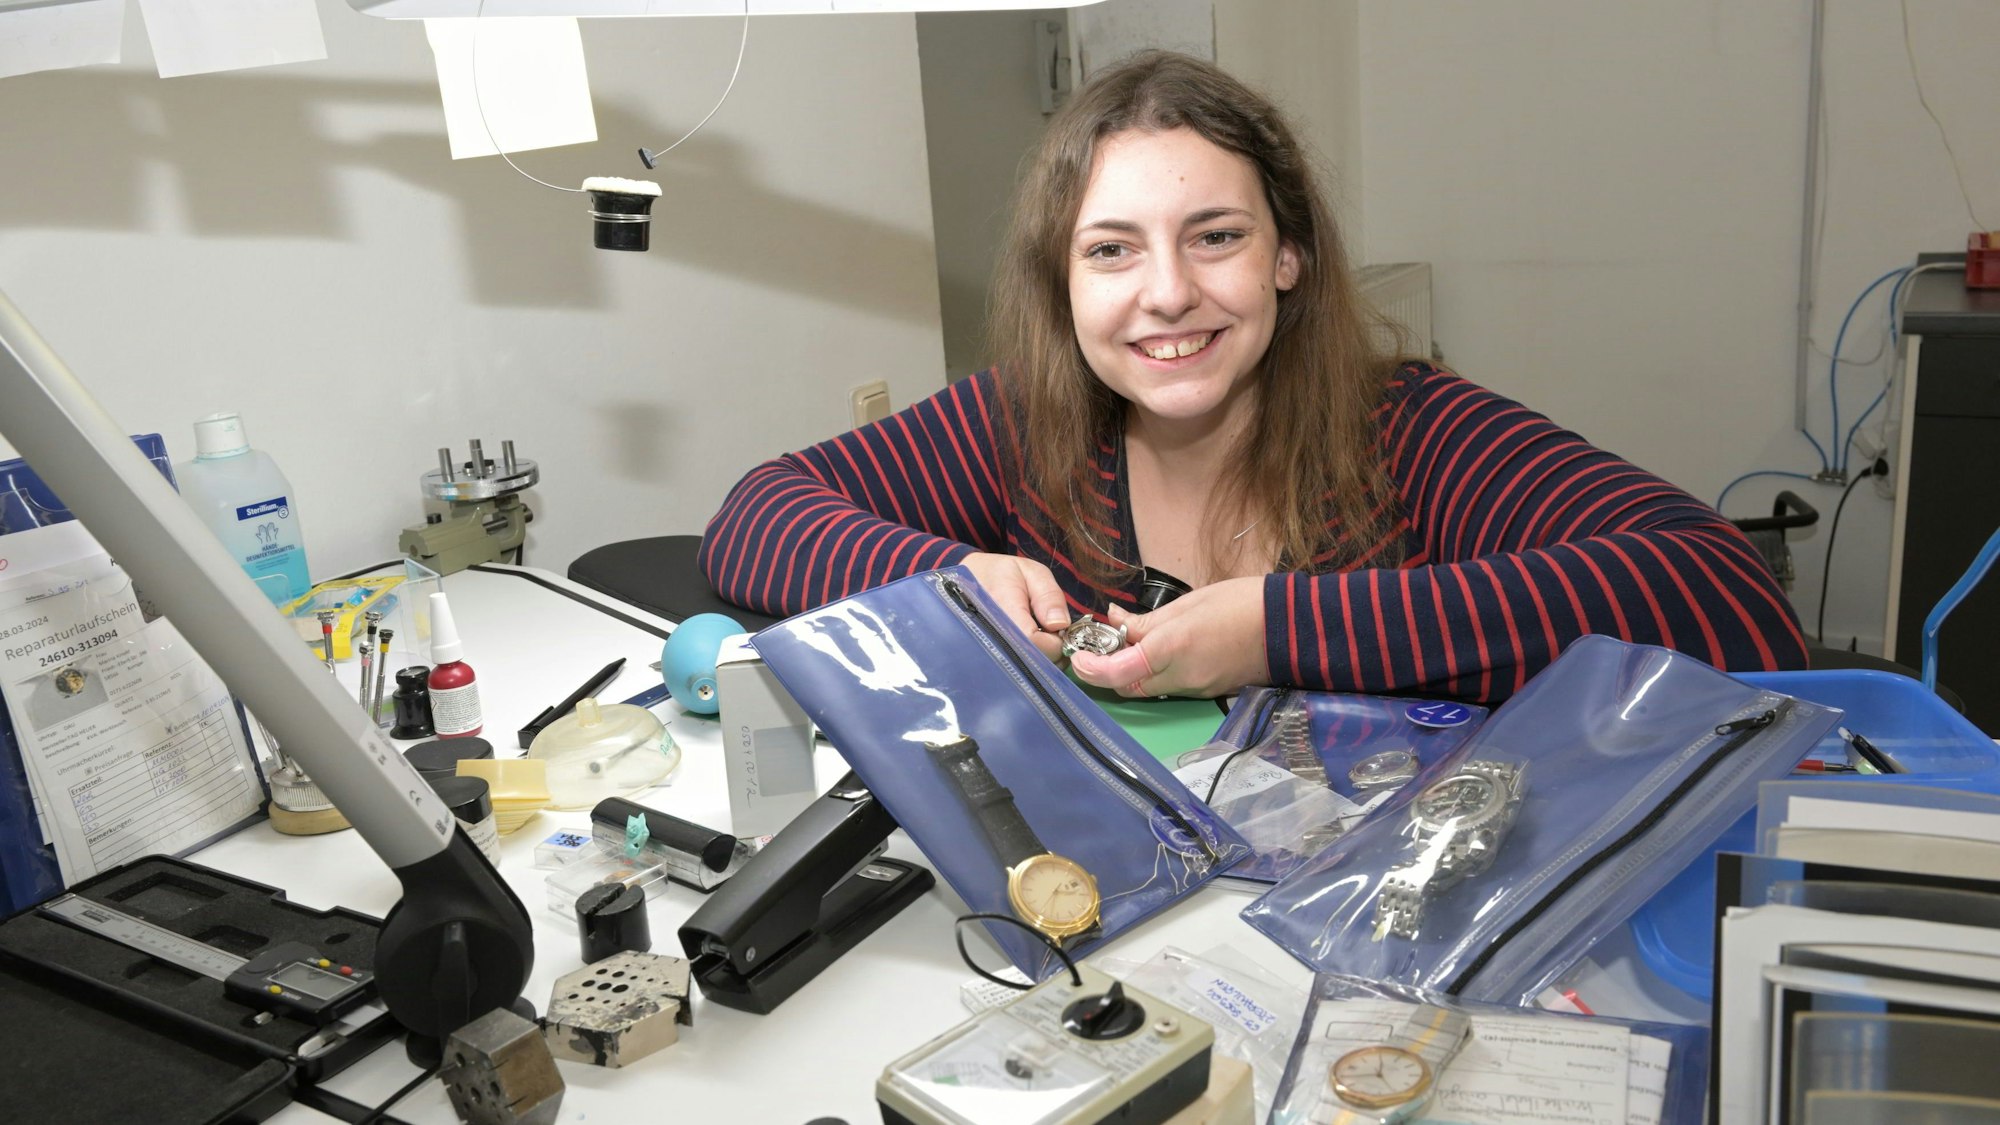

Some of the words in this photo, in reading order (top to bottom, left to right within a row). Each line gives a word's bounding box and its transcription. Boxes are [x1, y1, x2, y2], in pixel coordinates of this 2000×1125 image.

[0, 616, 49, 641] 28.03.2024
[4, 602, 138, 661] Reparaturlaufschein
[39, 629, 119, 667] 24610-313094
[94, 750, 134, 772] Preisanfrage
[144, 741, 174, 758] Referenz:
[70, 776, 103, 796] Ersatzteil:
[88, 818, 133, 845] Bemerkungen:
